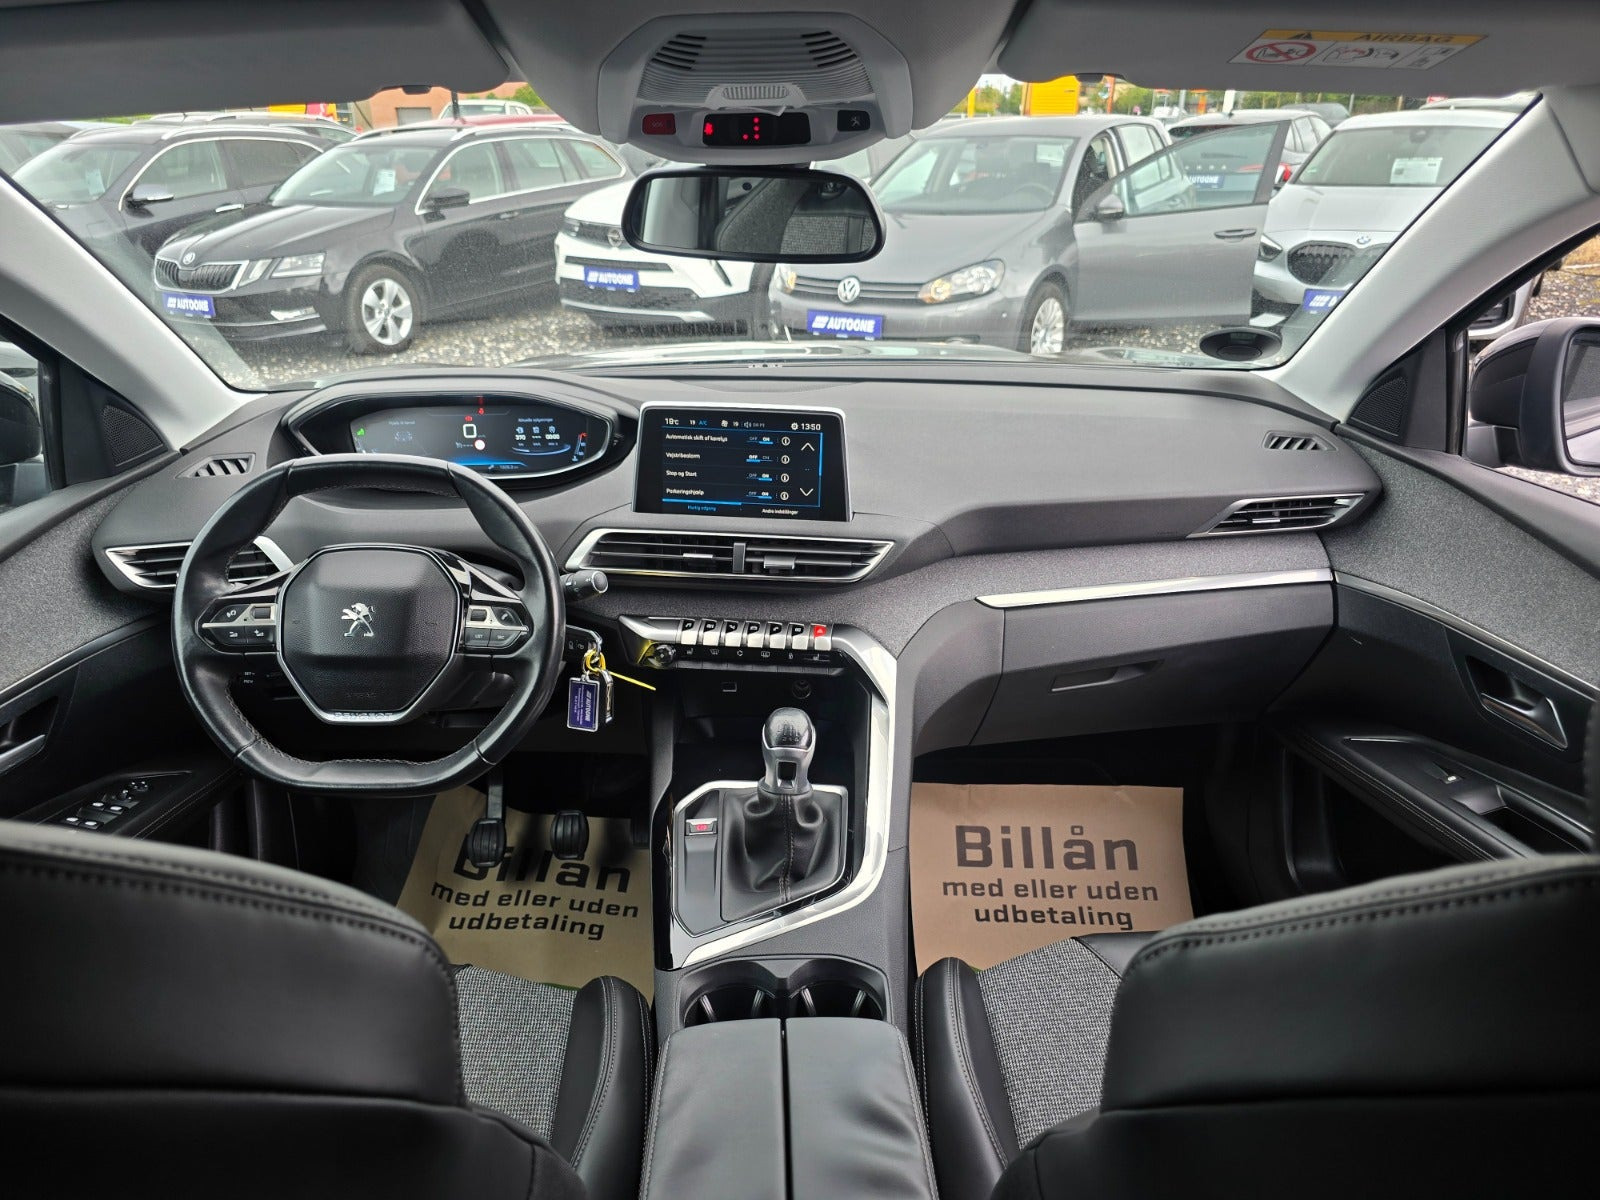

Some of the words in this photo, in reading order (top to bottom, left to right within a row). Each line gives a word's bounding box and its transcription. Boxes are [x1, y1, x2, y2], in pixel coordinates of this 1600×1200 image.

[1352, 33, 1455, 43] AIRBAG
[827, 317, 876, 334] AUTOONE
[955, 825, 1139, 871] Billån
[431, 881, 490, 907] med
[497, 889, 561, 908] eller
[568, 897, 639, 918] uden
[942, 878, 1004, 898] med
[1014, 879, 1077, 899] eller
[1087, 881, 1159, 901] uden
[448, 912, 605, 941] udbetaling
[974, 904, 1133, 931] udbetaling
